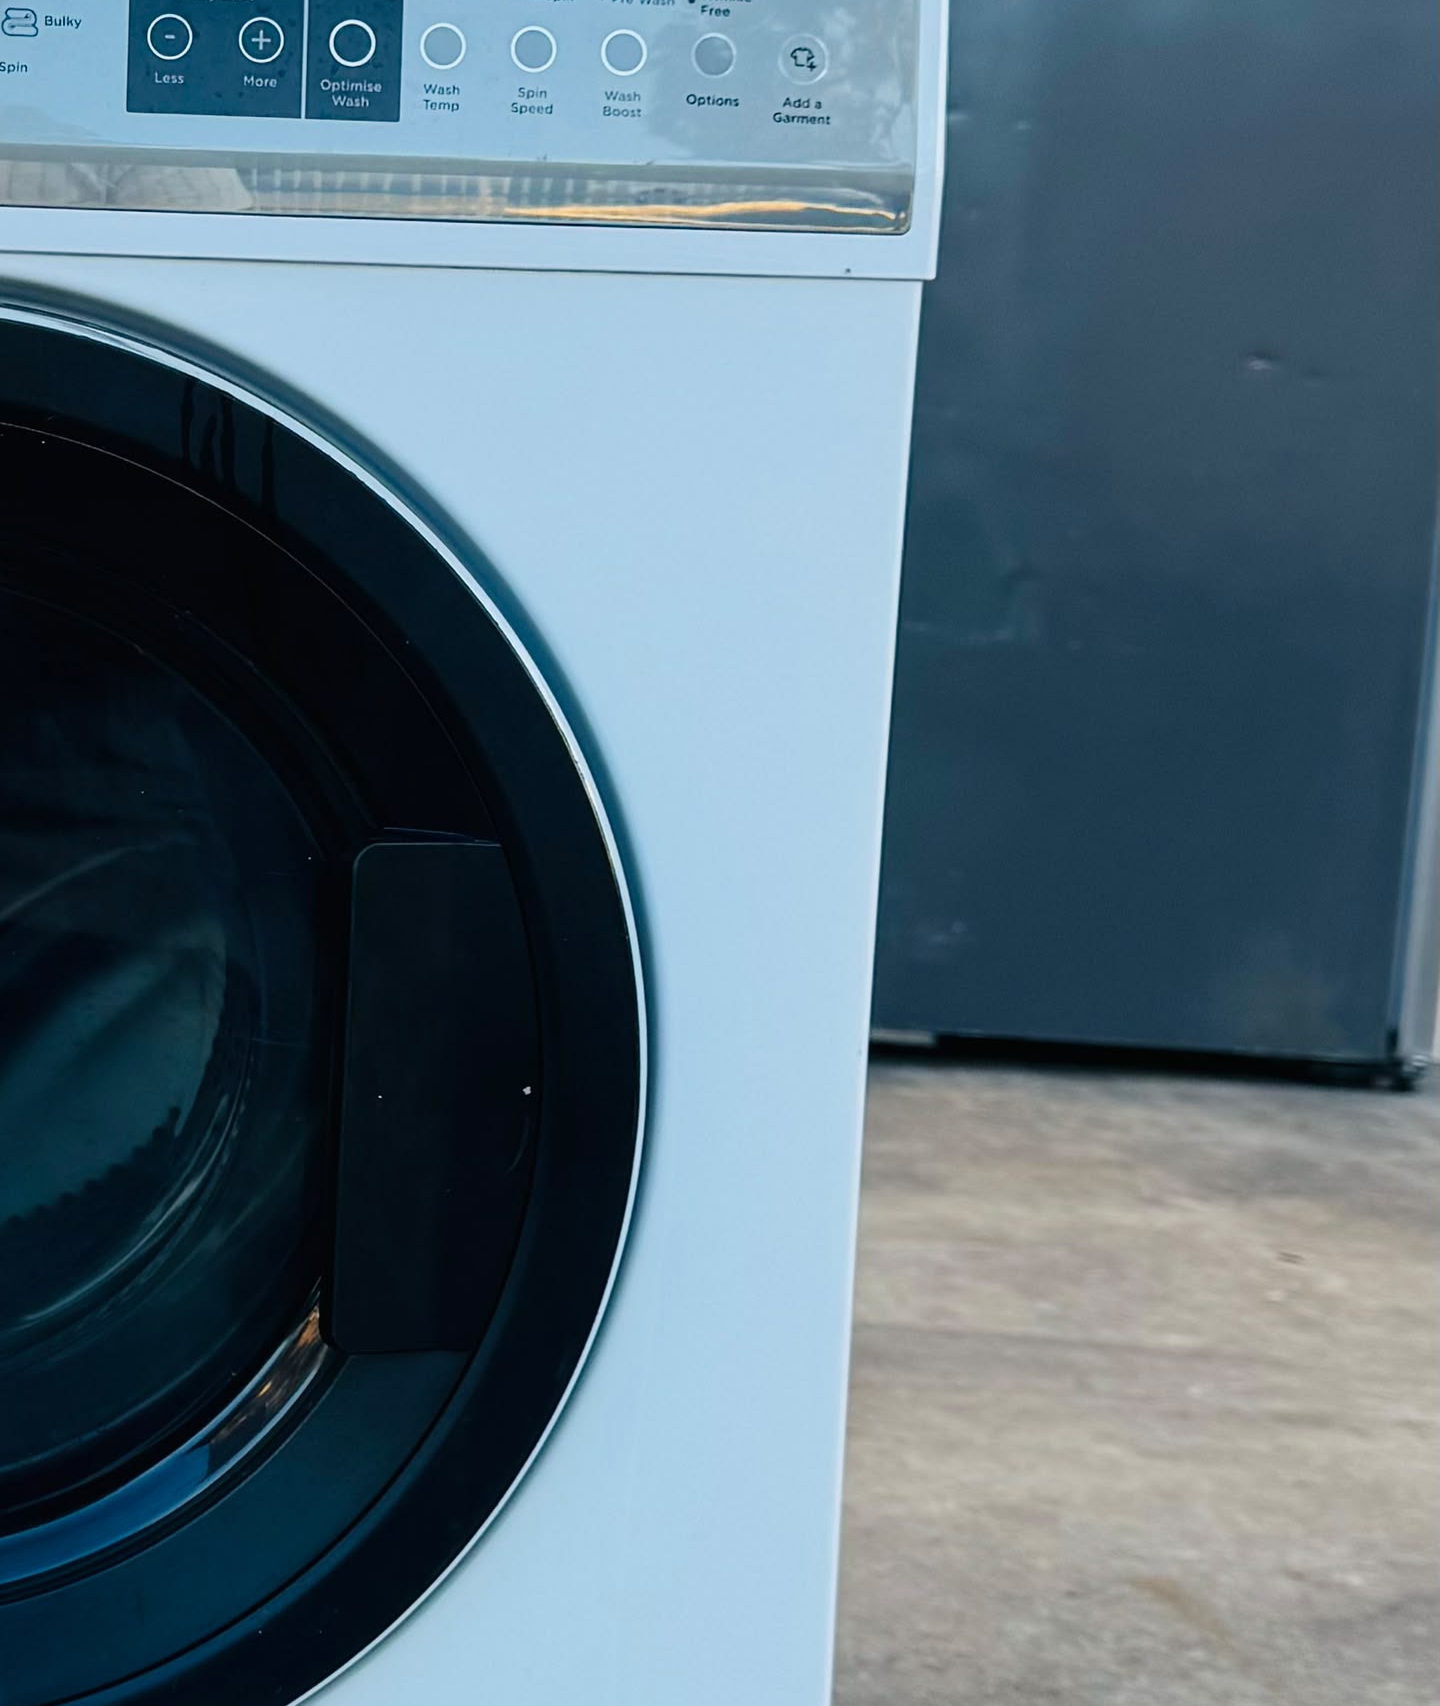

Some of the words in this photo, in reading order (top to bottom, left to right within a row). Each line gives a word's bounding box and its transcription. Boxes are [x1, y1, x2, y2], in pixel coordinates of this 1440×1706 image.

[700, 4, 730, 17] Free
[44, 15, 82, 29] Bulky
[155, 72, 184, 84] Less
[243, 75, 277, 88] More
[320, 79, 382, 93] Optimise
[424, 84, 461, 96] Wash
[518, 87, 547, 100] Spin
[605, 90, 641, 103] Wash
[332, 95, 369, 108] Wash
[424, 99, 460, 112] Temp
[686, 94, 740, 108] Options
[783, 96, 810, 109] Add
[814, 100, 822, 110] a
[511, 102, 553, 115] Speed
[603, 105, 642, 118] Boost
[773, 112, 831, 125] Garment
